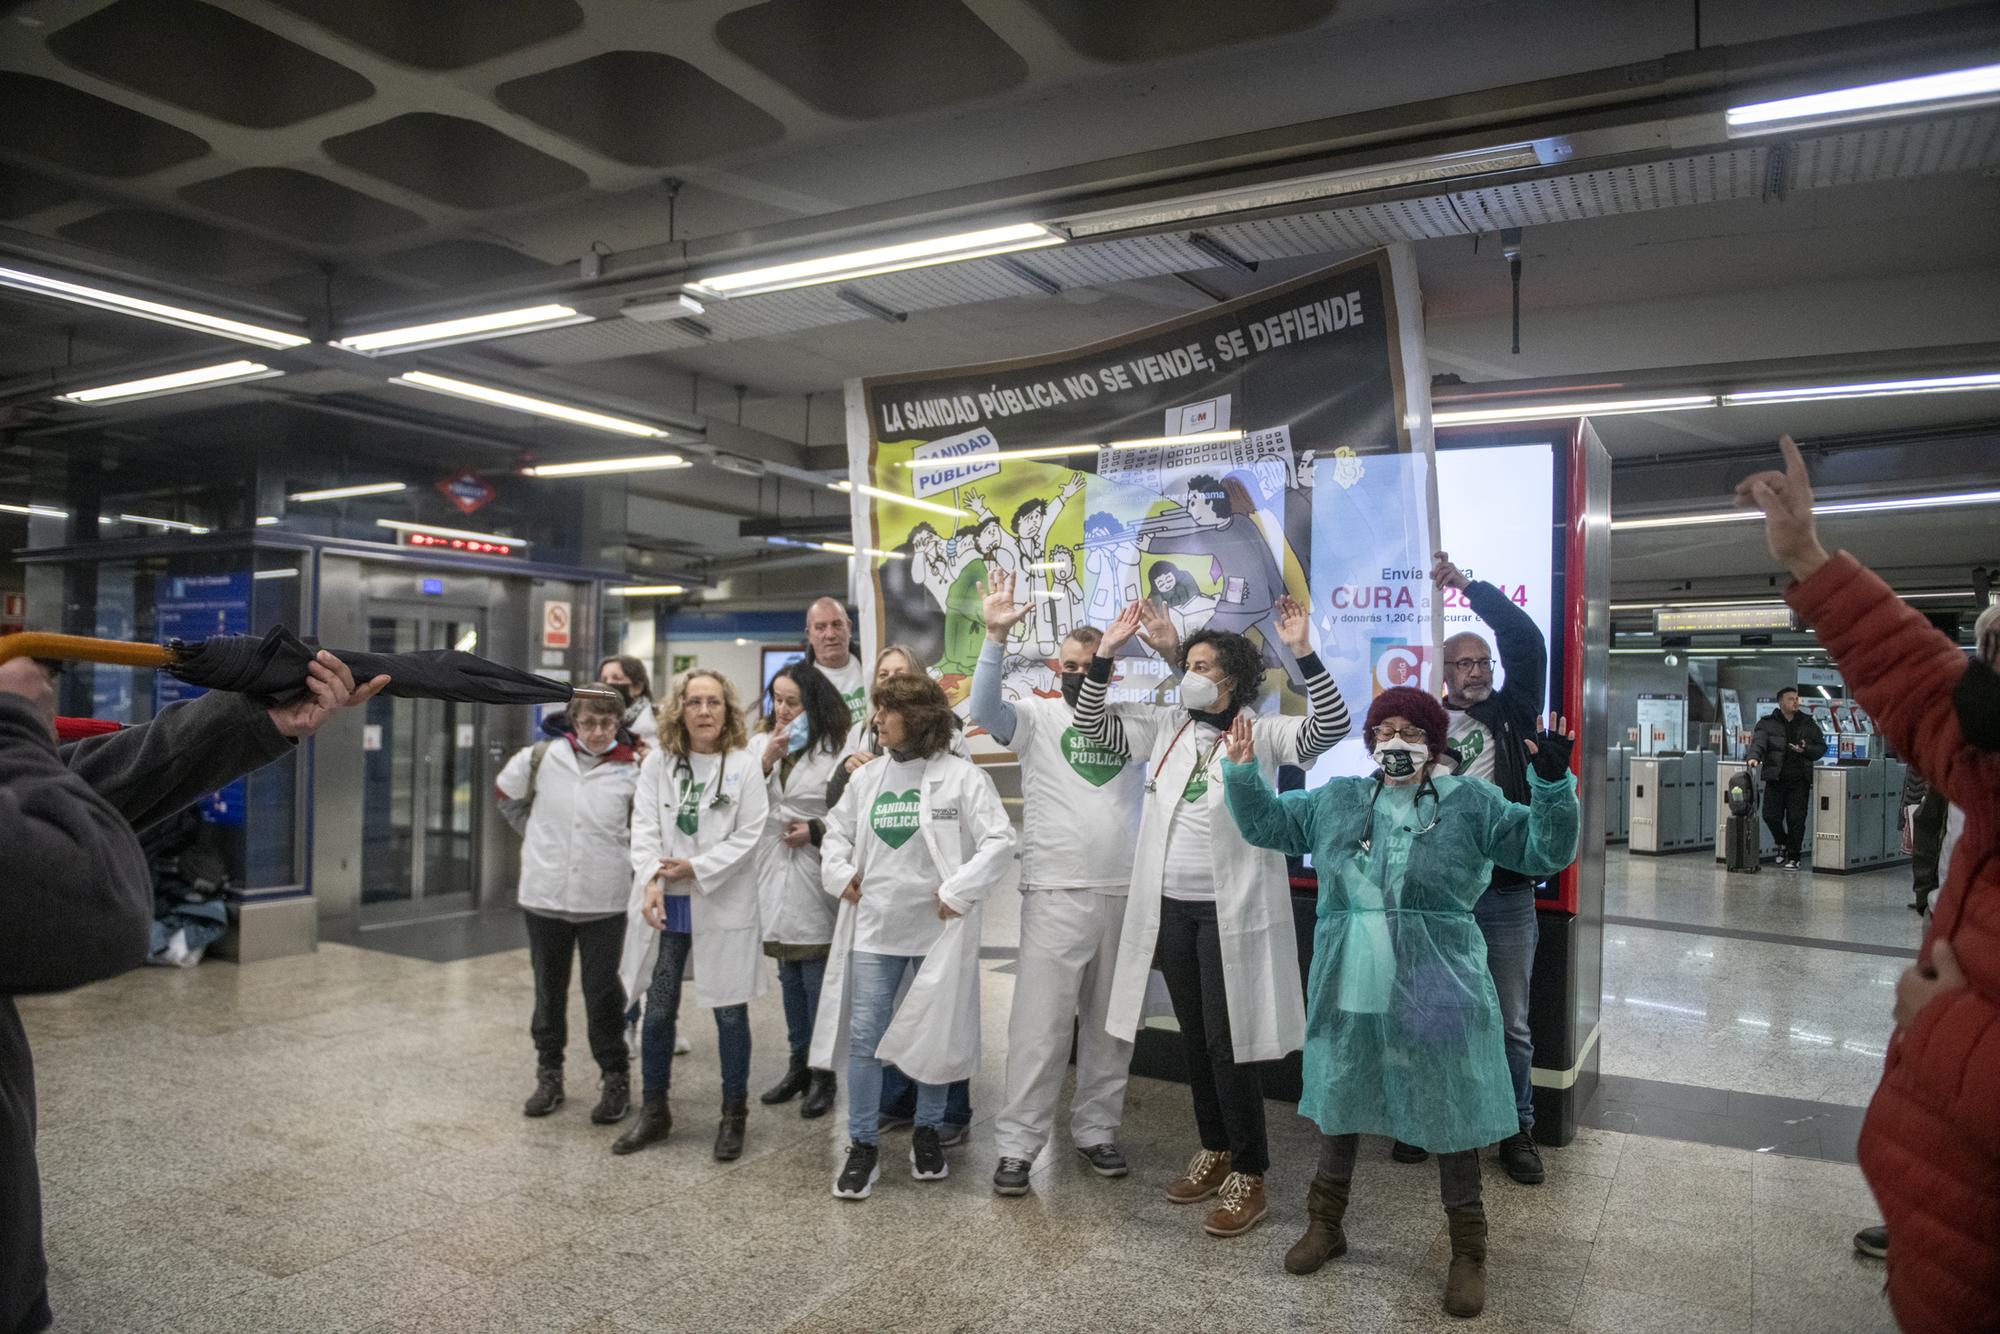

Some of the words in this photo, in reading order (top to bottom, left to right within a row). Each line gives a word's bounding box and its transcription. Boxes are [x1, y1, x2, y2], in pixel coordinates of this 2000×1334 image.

[882, 402, 904, 432] LA
[904, 395, 979, 430] SANIDAD
[978, 384, 1065, 419] PÚBLICA
[1064, 373, 1099, 400] NO
[1099, 364, 1132, 393] SE
[1128, 342, 1216, 385] VENDE,
[1215, 328, 1249, 361] SE
[1249, 290, 1364, 352] DEFIENDE
[1382, 567, 1423, 580] Envía
[1331, 586, 1414, 609] CURA
[1332, 615, 1337, 624] y
[1340, 613, 1382, 623] donarás
[1385, 613, 1414, 624] 1,20€
[1443, 614, 1472, 622] curar
[1163, 684, 1181, 703] al
[1070, 748, 1122, 767] PÚBLICA
[875, 801, 920, 815] SANIDAD
[873, 815, 919, 829] PÚBLICA
